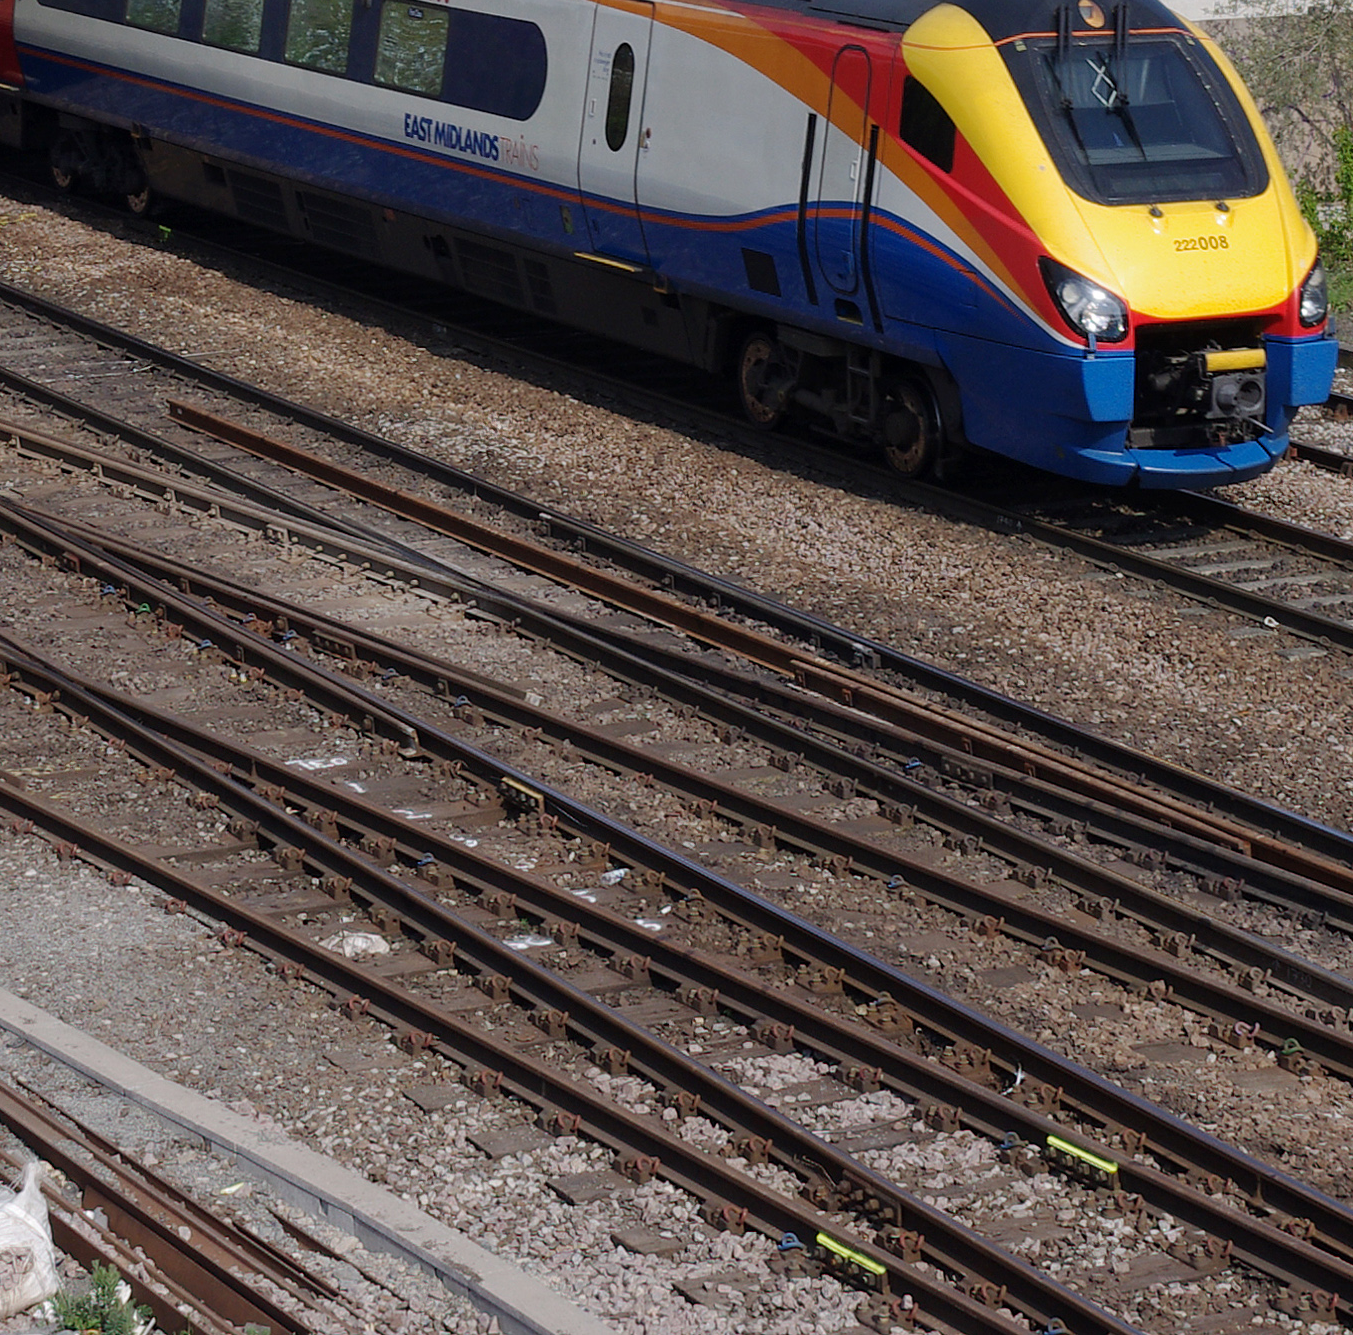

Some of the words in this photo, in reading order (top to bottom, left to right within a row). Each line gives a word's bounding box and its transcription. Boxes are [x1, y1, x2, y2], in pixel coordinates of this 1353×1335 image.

[404, 113, 433, 143] EAST
[434, 121, 499, 161] MIDLANDS
[1173, 235, 1229, 252] 222008
